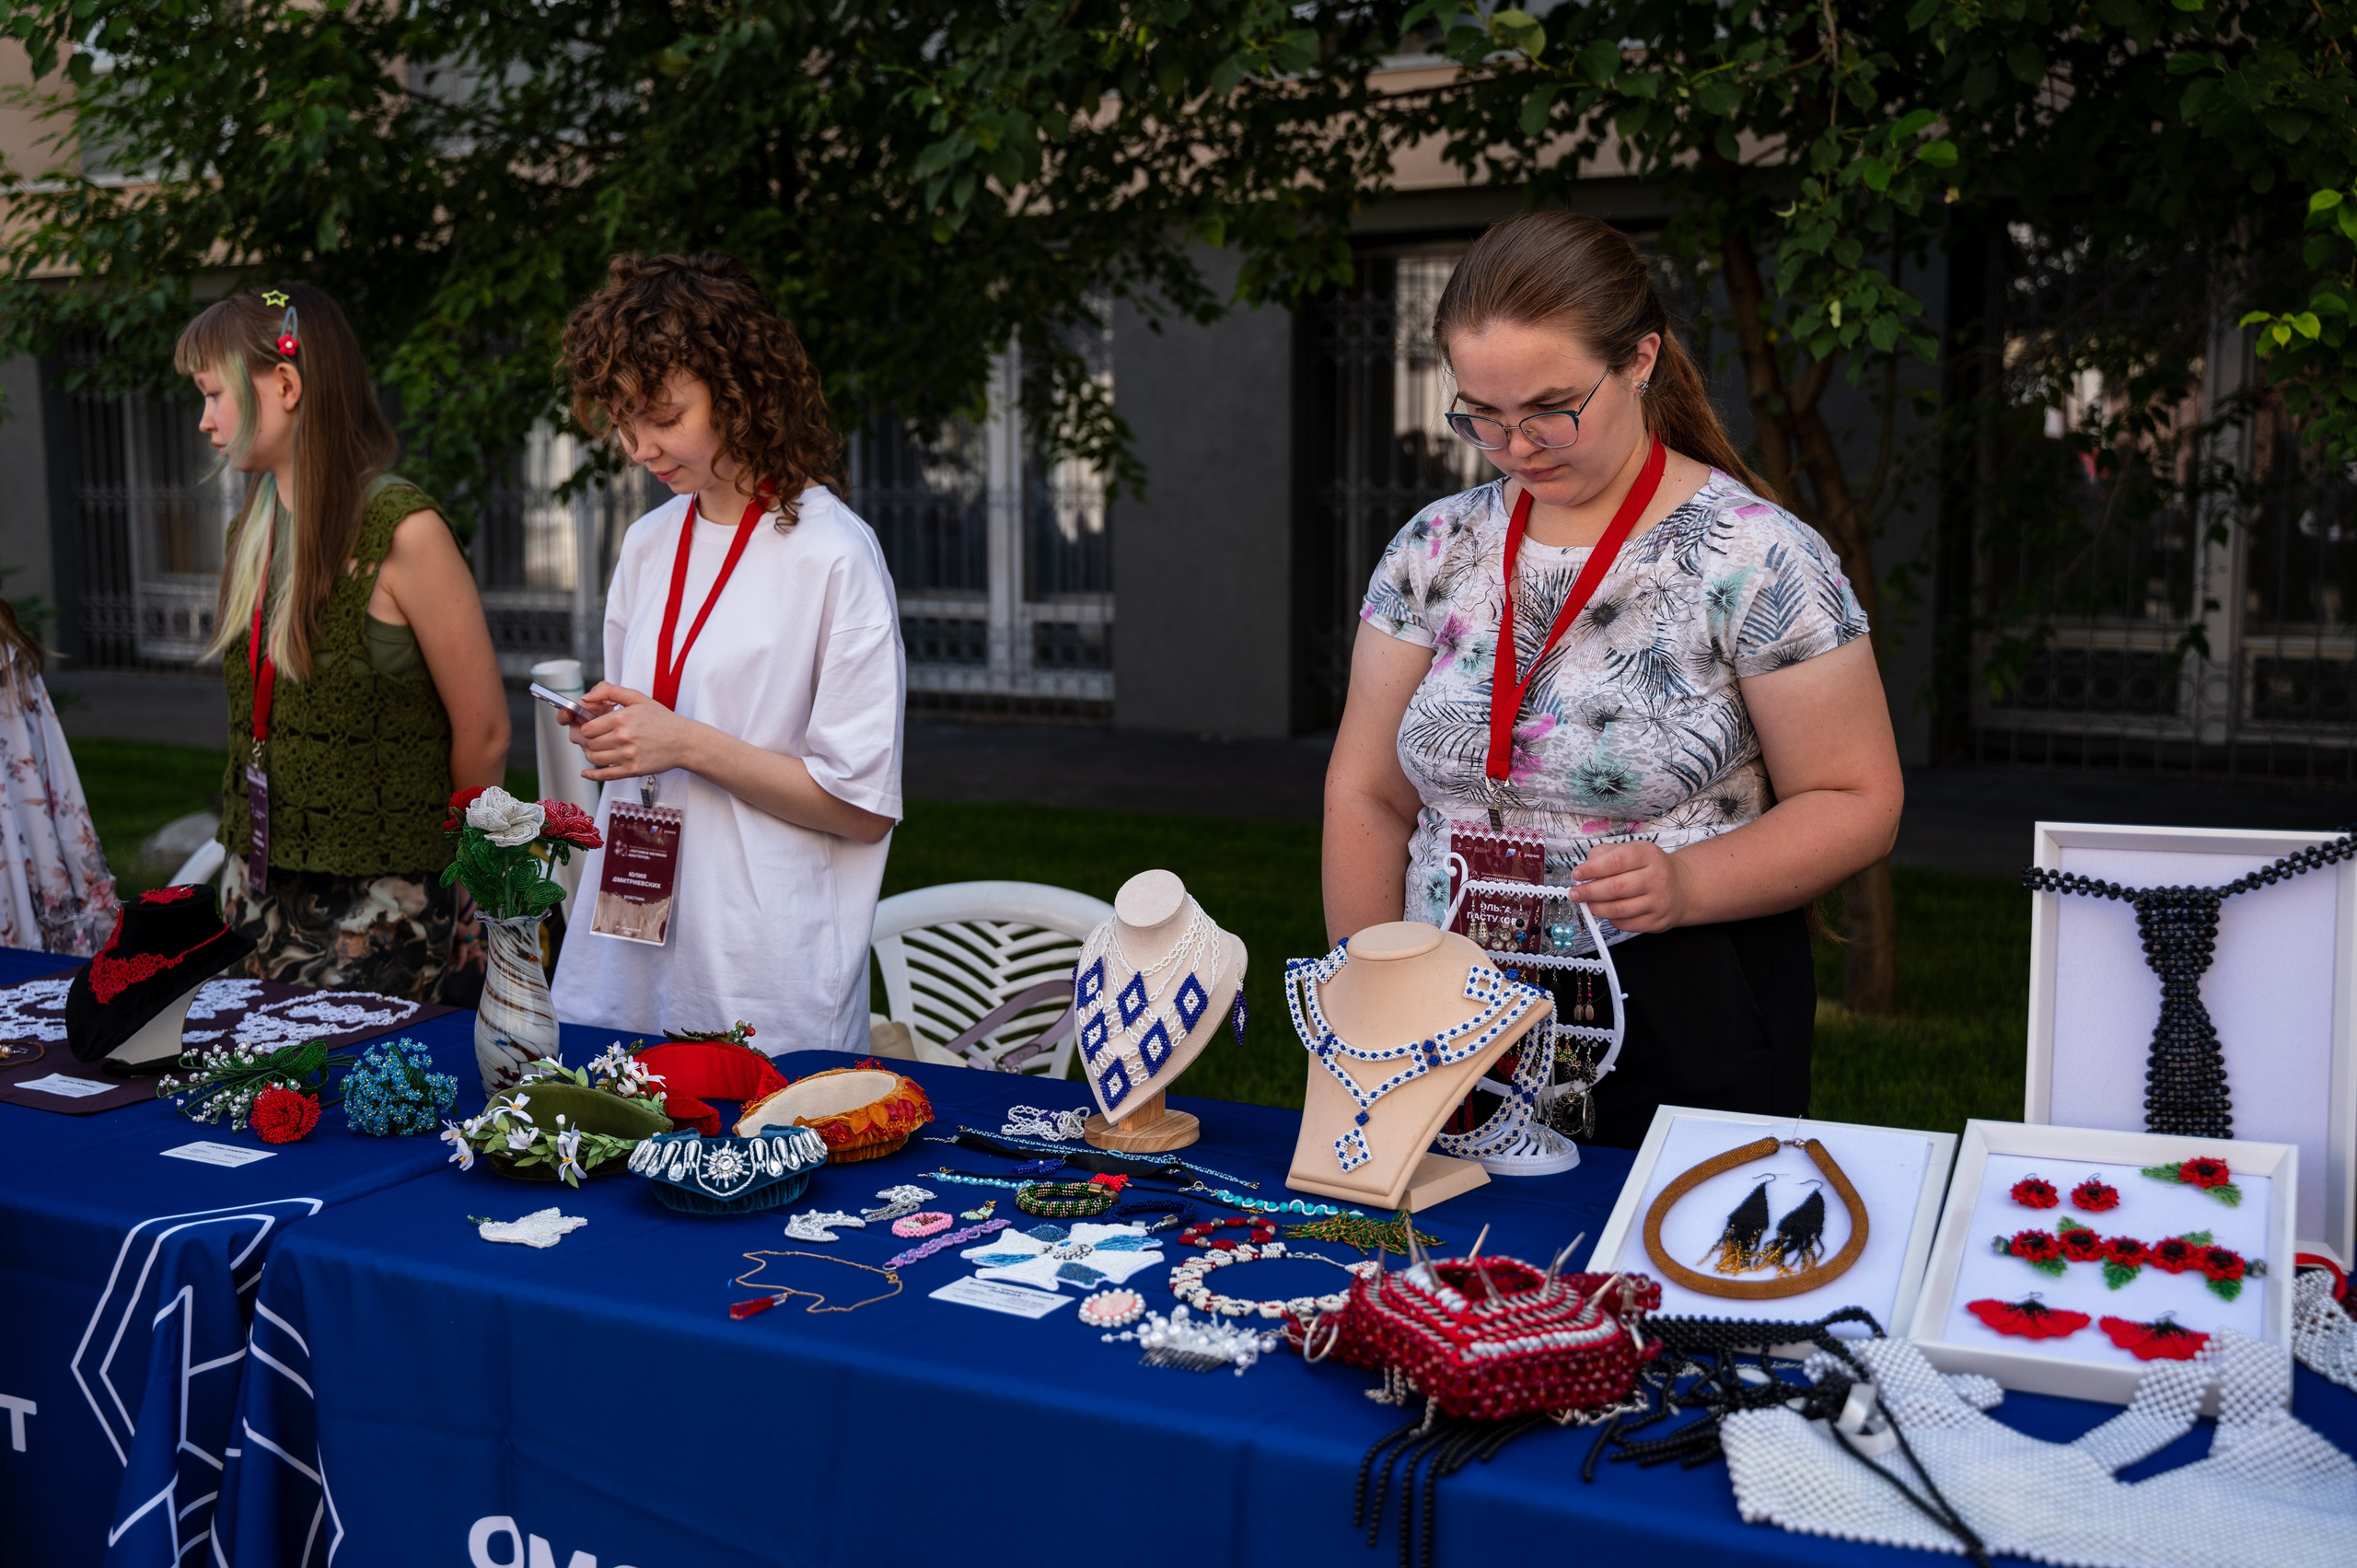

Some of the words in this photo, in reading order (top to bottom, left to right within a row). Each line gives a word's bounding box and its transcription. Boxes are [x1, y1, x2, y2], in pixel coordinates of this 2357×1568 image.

[628, 871, 647, 879] ЮЛИЯ
[612, 877, 662, 889] ДМИТРИЕВСКИХ
[469, 1516, 639, 1568] ОМ
